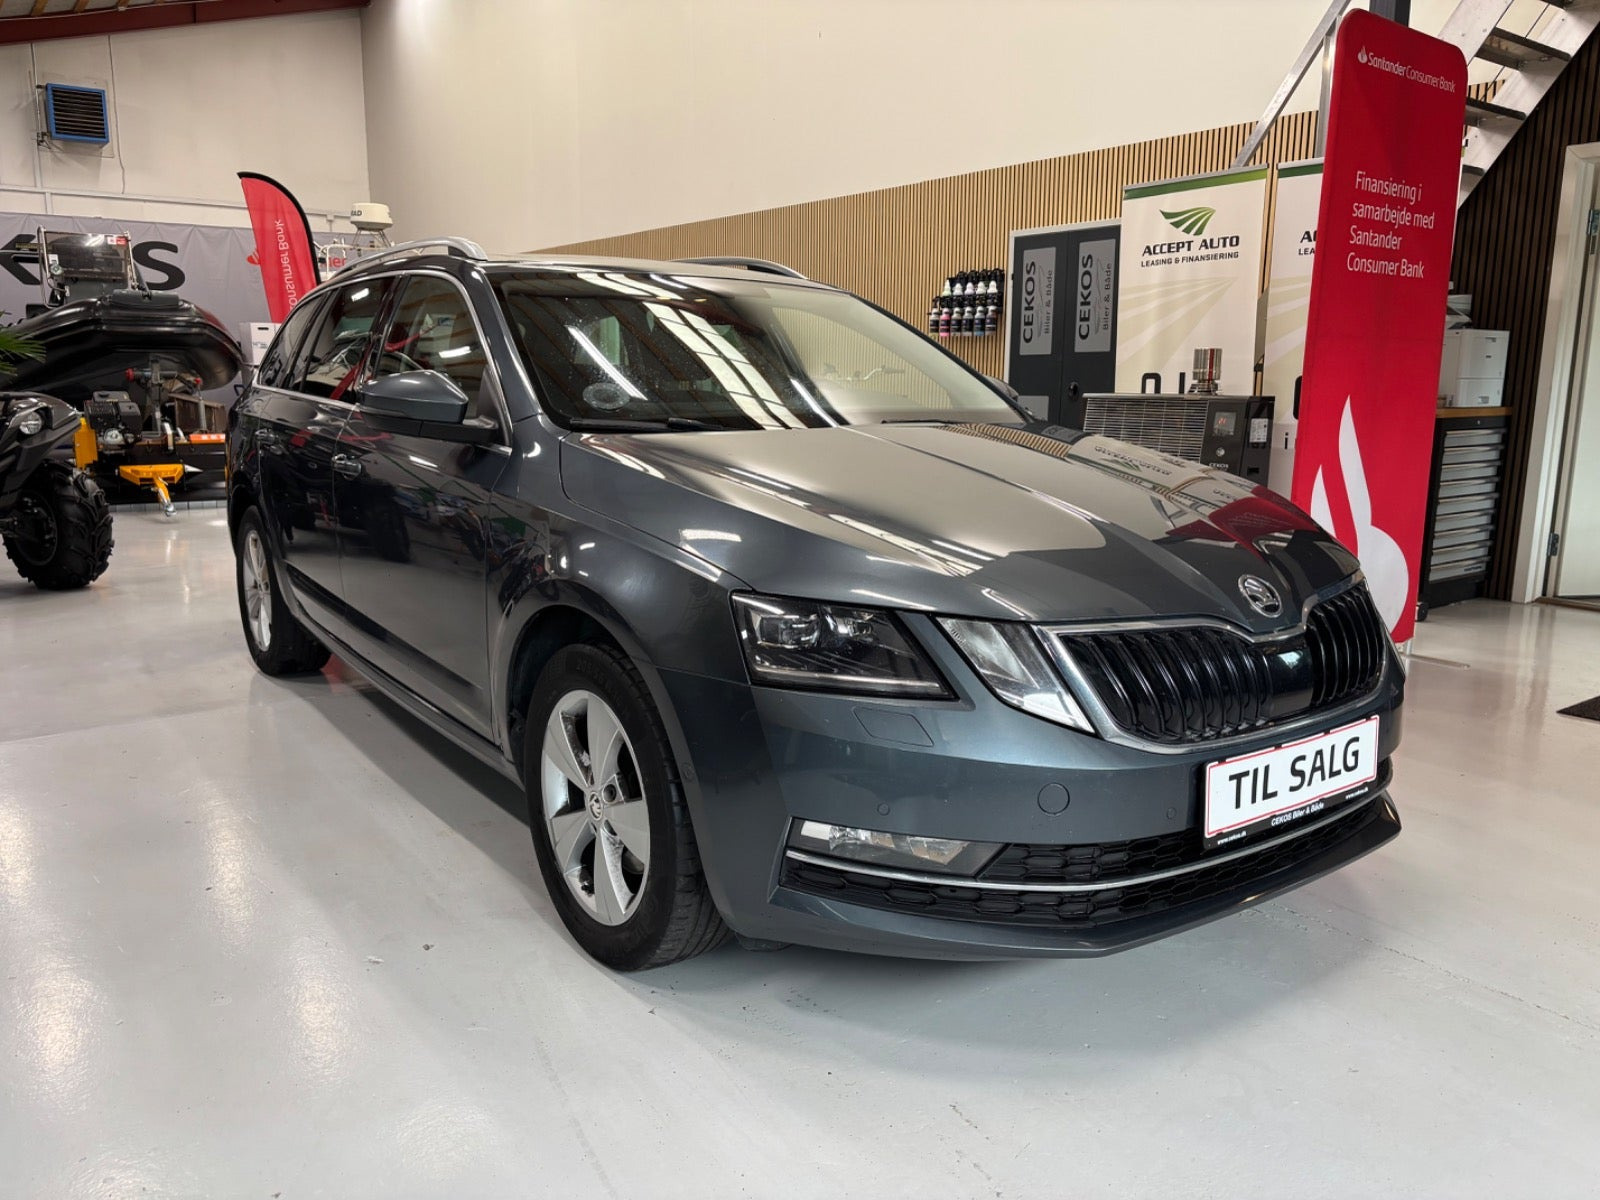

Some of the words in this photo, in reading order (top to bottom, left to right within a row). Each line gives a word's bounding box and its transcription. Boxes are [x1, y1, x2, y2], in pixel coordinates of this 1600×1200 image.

[1367, 52, 1406, 76] Santander
[1406, 65, 1439, 88] Consumer
[1439, 76, 1456, 93] Bank
[1355, 170, 1416, 205] Finansiering
[1418, 183, 1423, 201] i
[1352, 202, 1411, 228] samarbejde
[1413, 213, 1435, 229] med
[1142, 240, 1194, 257] ACCEPT
[1199, 235, 1240, 250] AUTO
[1349, 225, 1402, 250] Santander
[1141, 258, 1173, 268] LEASING
[1181, 251, 1239, 264] FINANSIERING
[1347, 252, 1399, 276] Consumer
[1401, 259, 1424, 279] Bank
[1023, 261, 1036, 343] CEKOS
[1079, 254, 1093, 340] CEKOS
[1229, 764, 1278, 809] TIL
[1289, 736, 1360, 792] SALG
[1271, 812, 1292, 826] CEKOS
